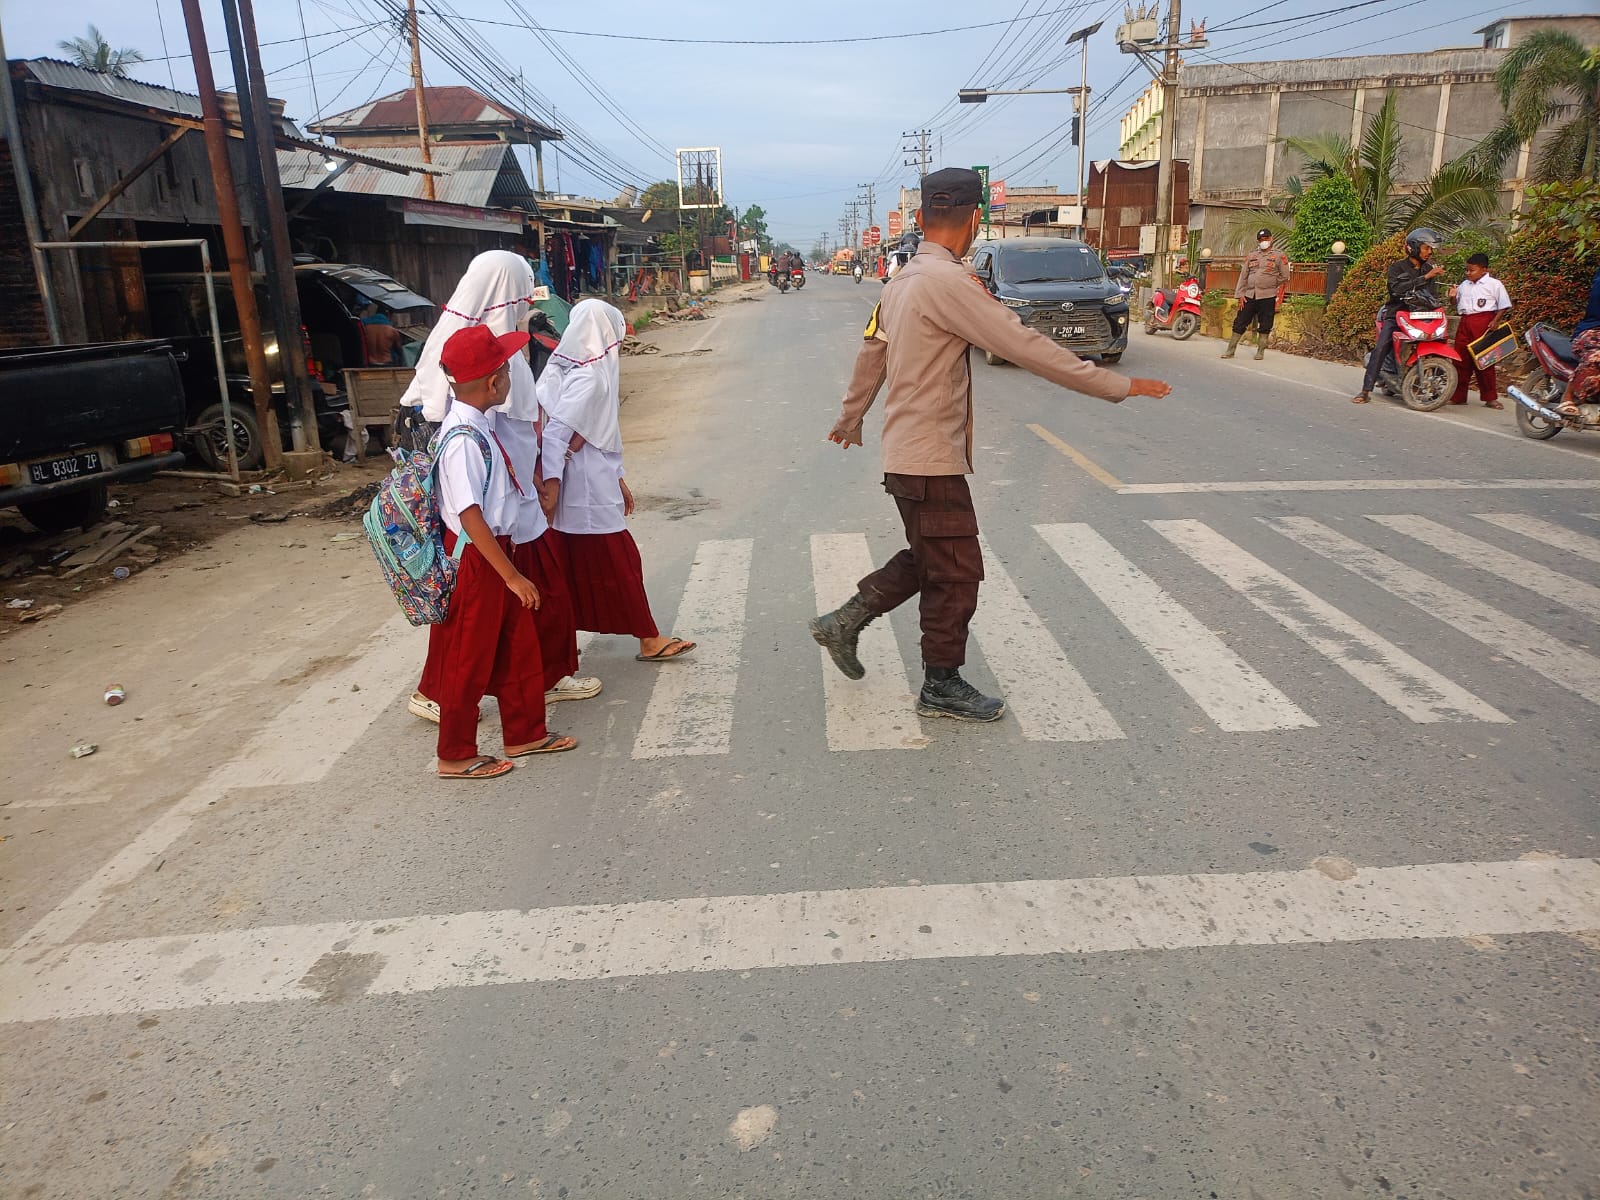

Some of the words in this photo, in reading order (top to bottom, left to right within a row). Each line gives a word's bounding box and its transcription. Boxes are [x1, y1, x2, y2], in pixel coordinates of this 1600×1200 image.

[33, 465, 48, 480] BL
[52, 458, 80, 476] 8302
[84, 454, 96, 469] ZP
